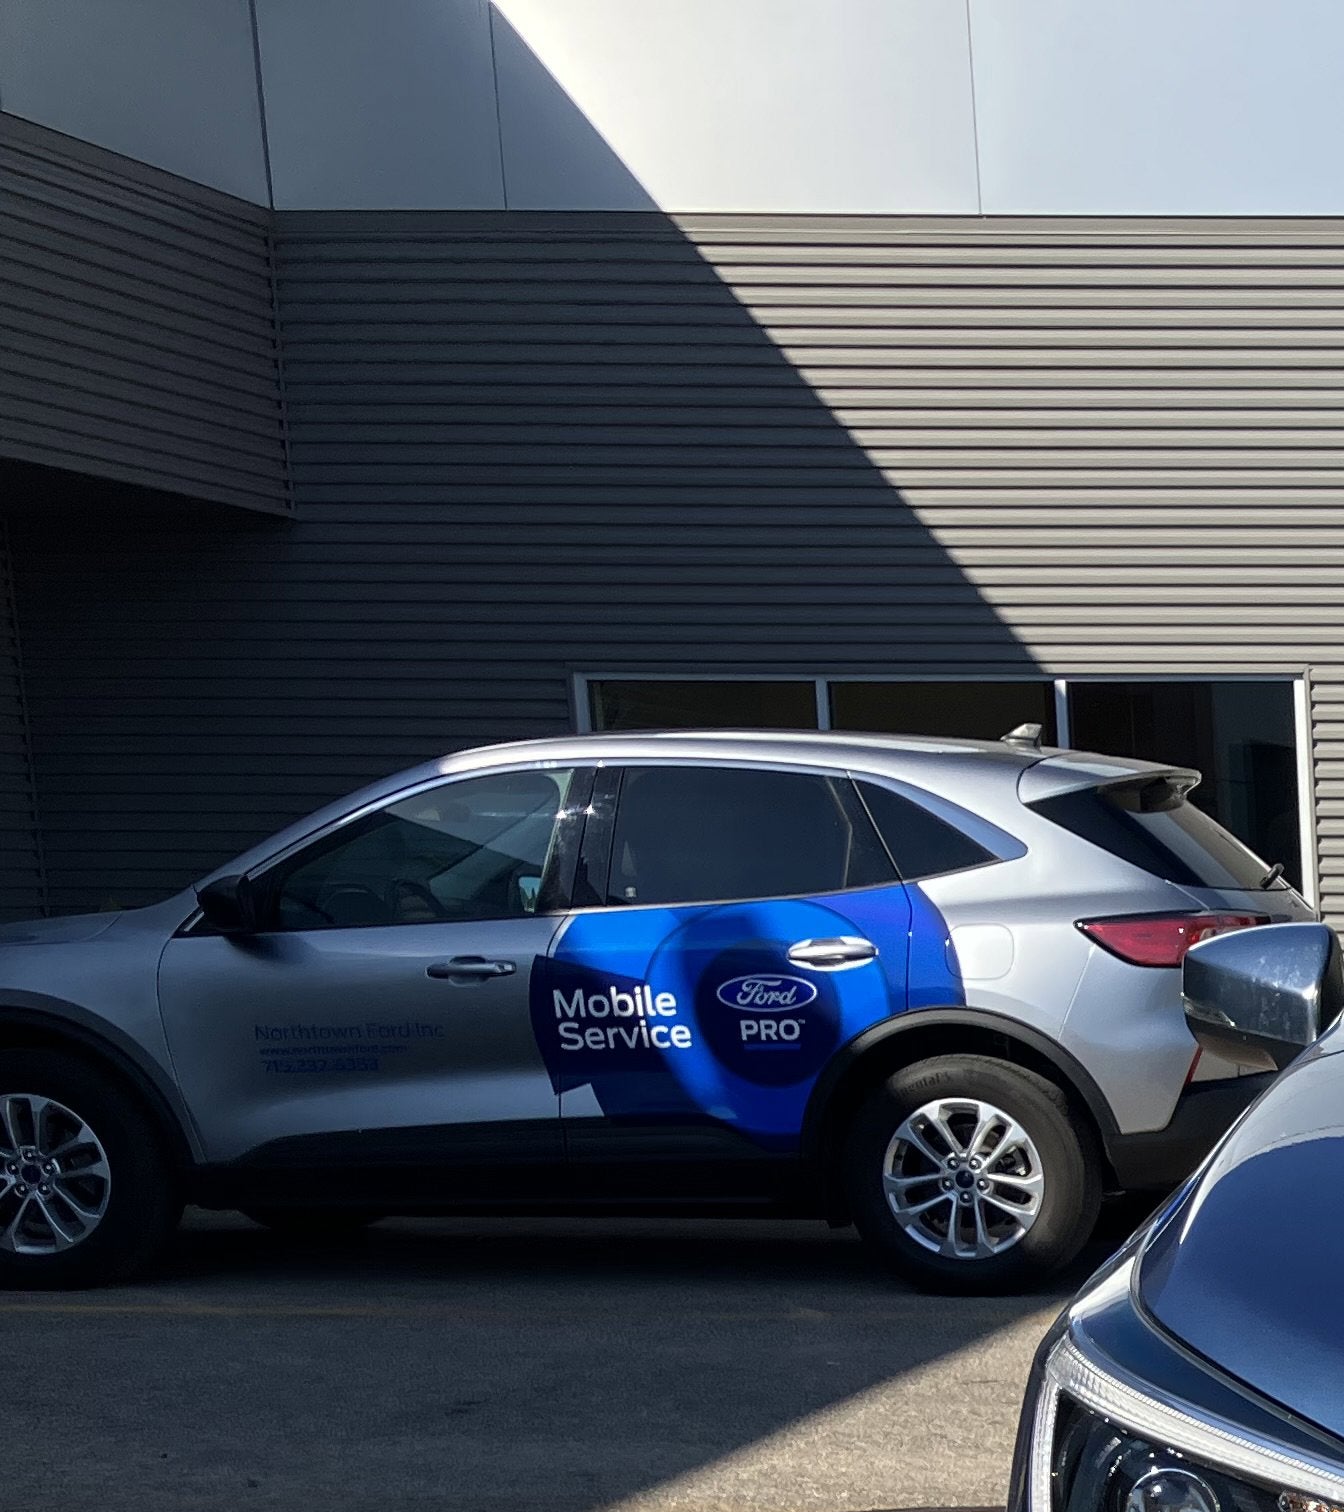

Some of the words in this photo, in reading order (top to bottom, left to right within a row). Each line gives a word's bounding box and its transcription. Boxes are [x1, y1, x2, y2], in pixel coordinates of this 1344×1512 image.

[553, 985, 677, 1019] Mobile
[736, 979, 796, 1005] Ford
[255, 1023, 362, 1041] Northtown
[366, 1022, 410, 1039] Ford
[558, 1020, 692, 1050] Service
[740, 1019, 801, 1041] PRO
